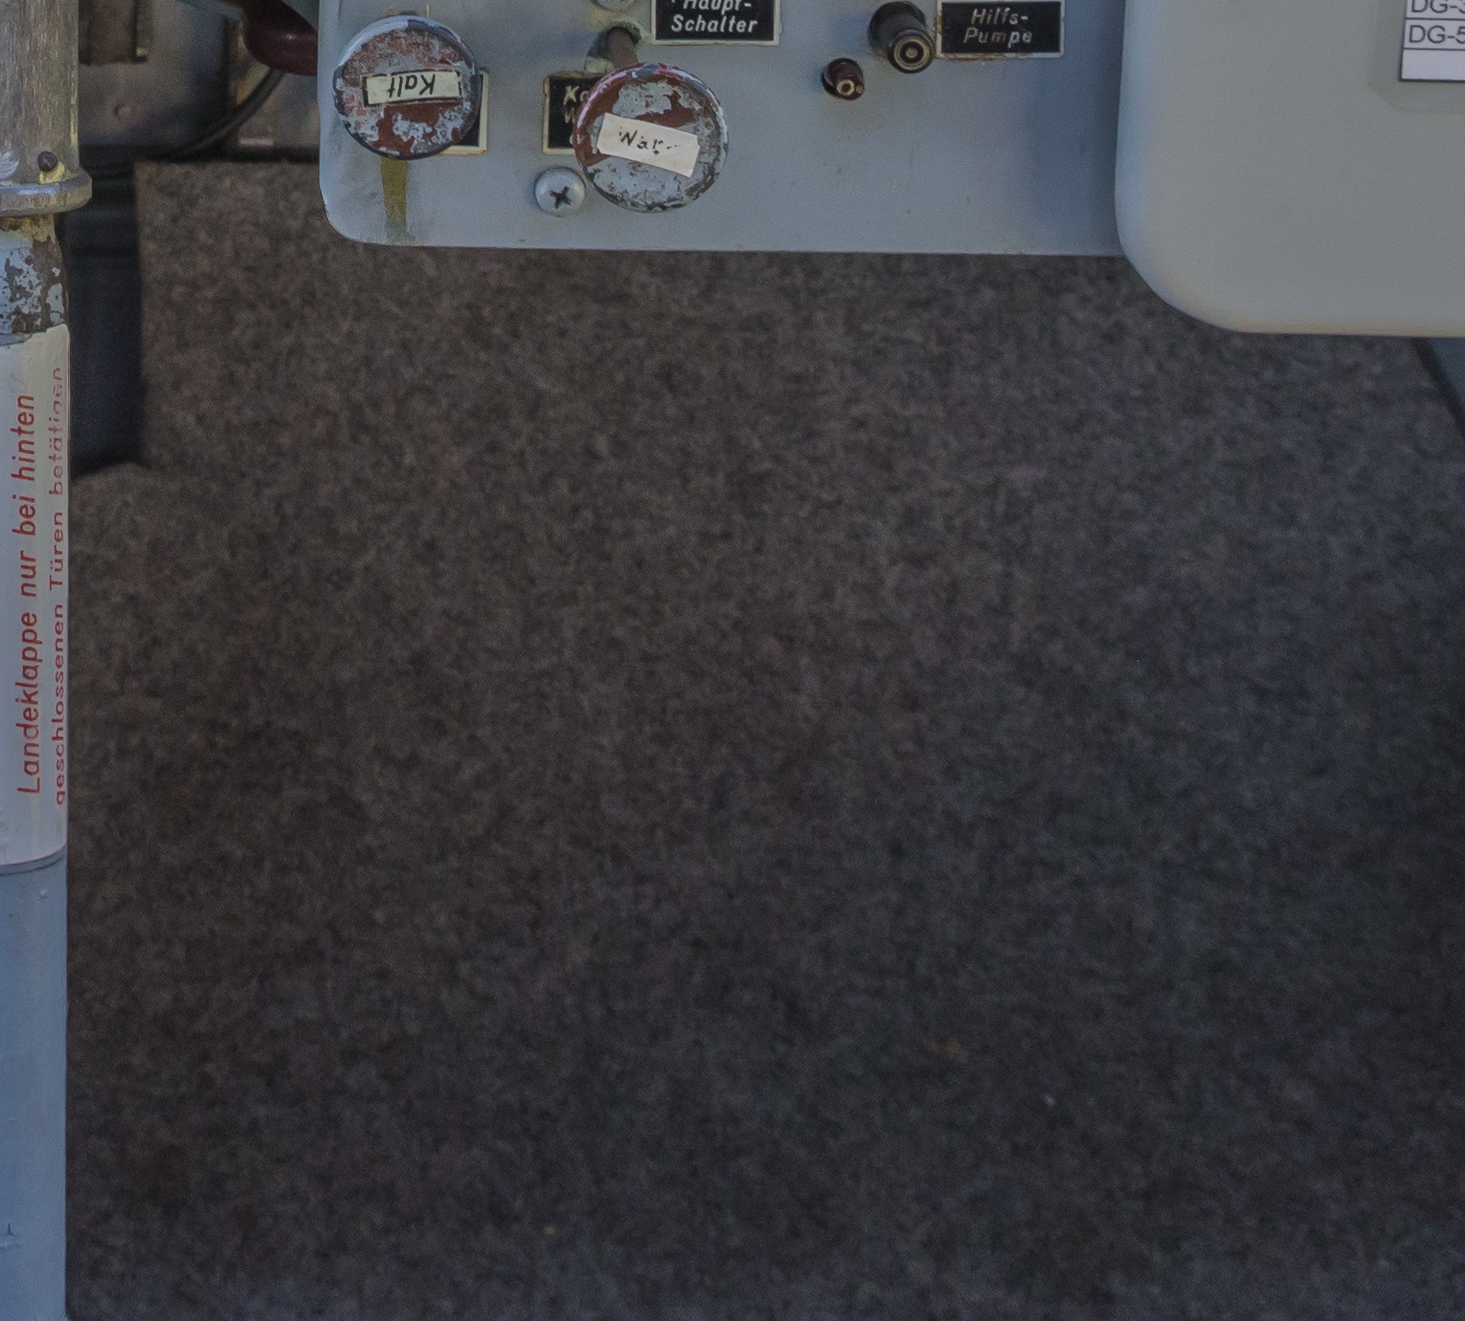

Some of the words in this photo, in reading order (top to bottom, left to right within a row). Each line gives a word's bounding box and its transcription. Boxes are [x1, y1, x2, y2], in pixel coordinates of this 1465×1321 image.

[10, 394, 36, 480] hinten
[11, 492, 37, 536] bei
[19, 550, 37, 600] nur
[15, 611, 43, 795] Landeklappe
